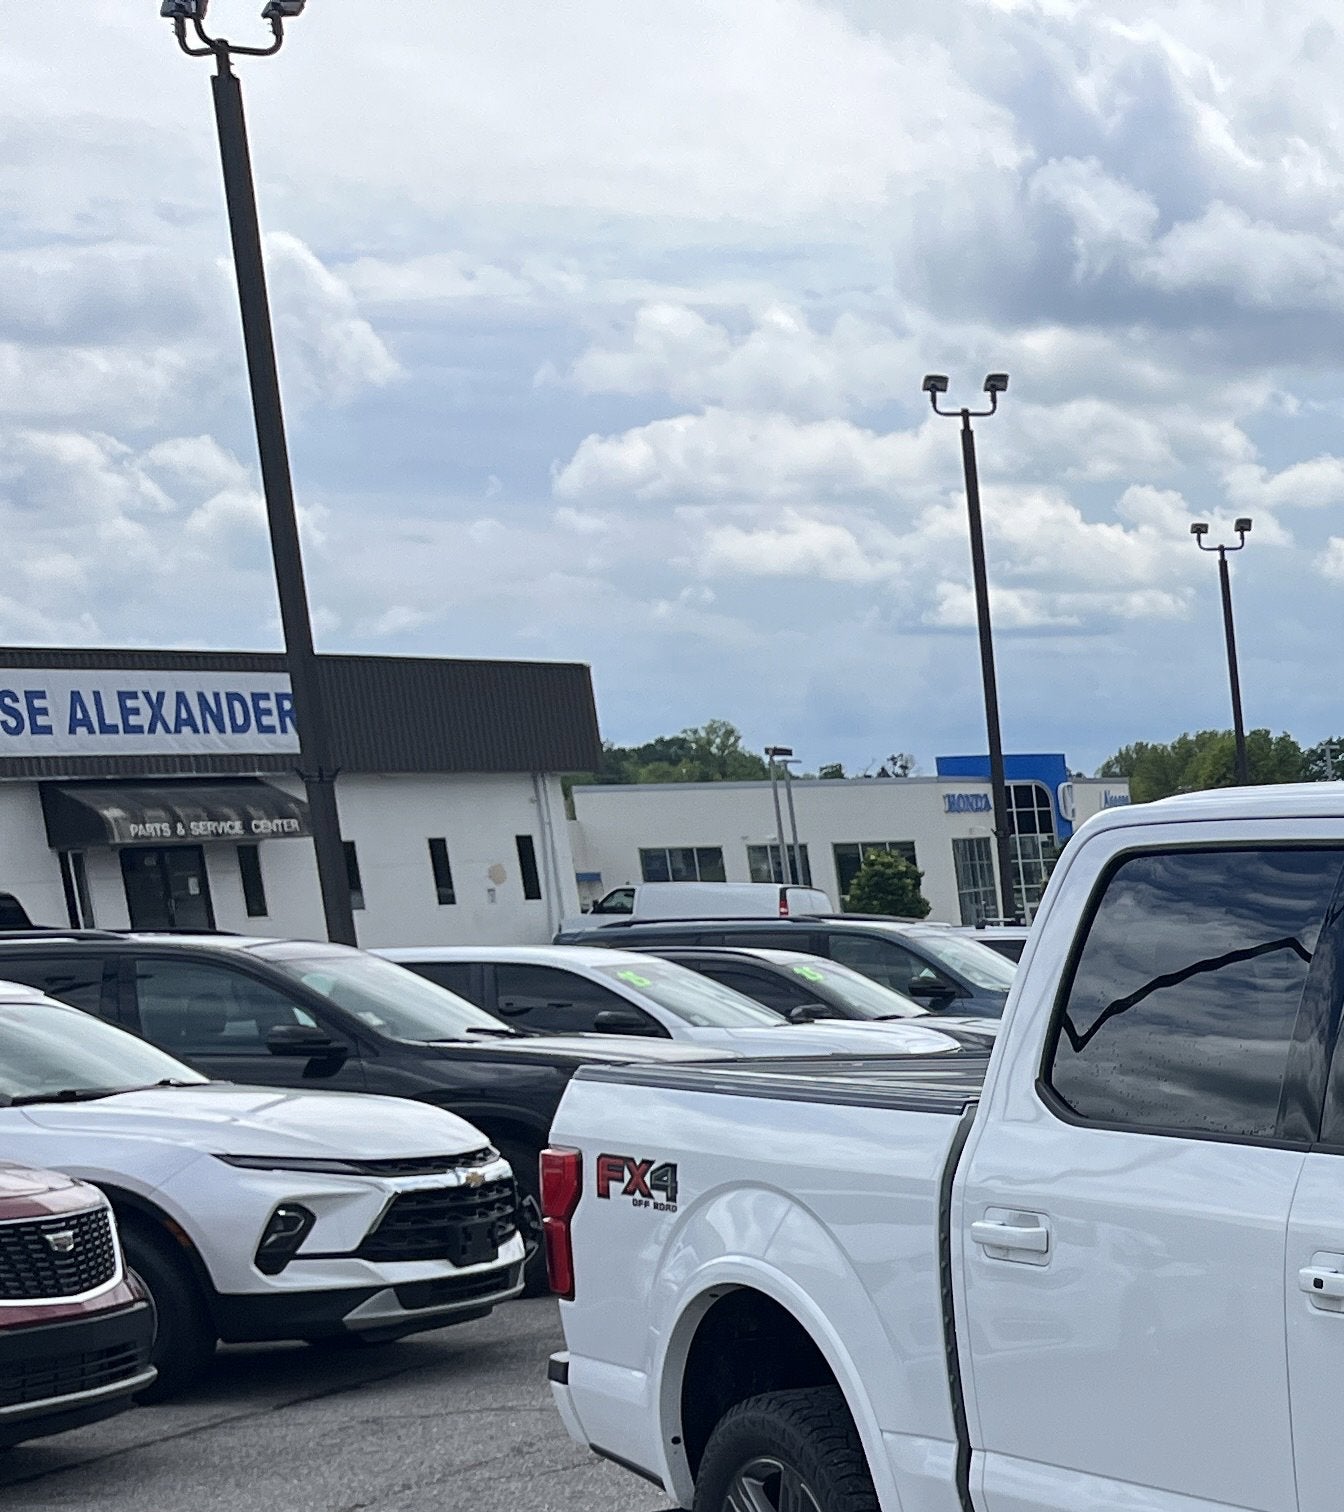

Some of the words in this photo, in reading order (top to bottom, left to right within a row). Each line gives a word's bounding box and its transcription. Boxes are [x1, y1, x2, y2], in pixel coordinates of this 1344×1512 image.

[68, 690, 297, 735] ALEXANDER
[943, 793, 993, 814] HONDA
[129, 823, 171, 838] PARTS
[177, 822, 185, 836] &
[190, 819, 245, 836] SERVICE
[251, 818, 301, 834] CENTER
[596, 1153, 678, 1203] FX4
[632, 1198, 651, 1209] OFF
[653, 1202, 678, 1213] ROAD
